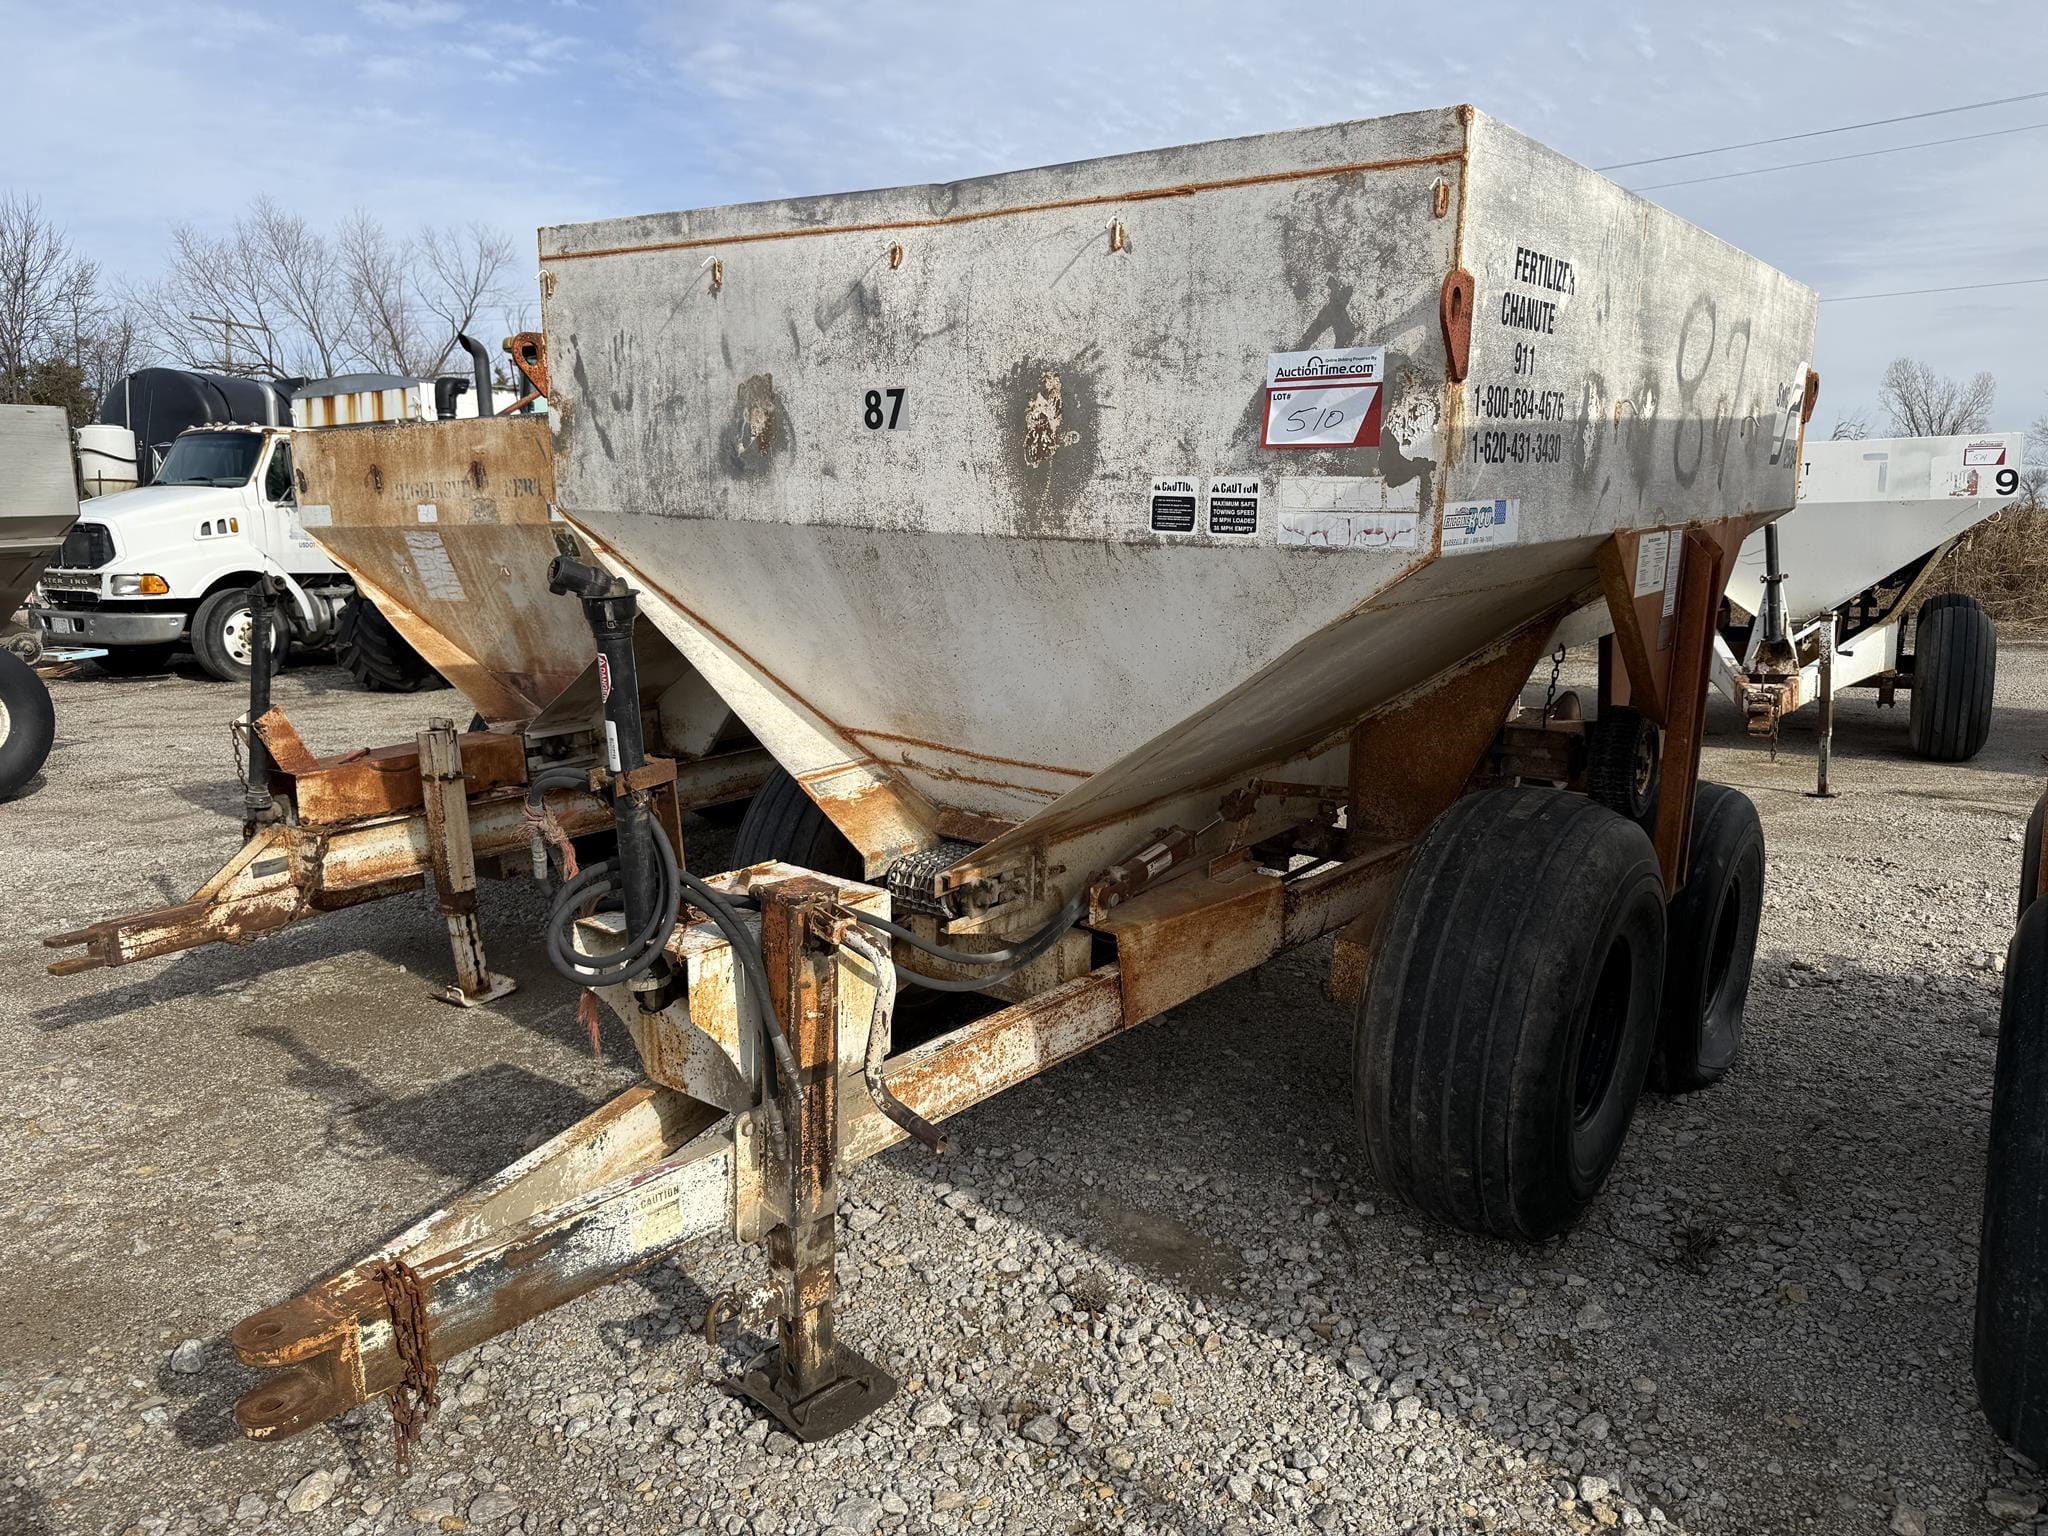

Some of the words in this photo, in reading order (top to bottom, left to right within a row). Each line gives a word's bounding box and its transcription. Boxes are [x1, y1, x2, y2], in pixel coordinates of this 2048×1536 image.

[1515, 246, 1575, 296] FERTILIZER
[1501, 291, 1556, 335] CHANUTE
[1275, 364, 1374, 378] AuctionTime.com
[1514, 341, 1535, 376] 911
[864, 388, 905, 430] 87
[1273, 393, 1292, 401] LOT#
[1474, 384, 1565, 423] 1-800-684-4676
[1286, 406, 1345, 432] 510
[1472, 431, 1562, 464] 1-620-431-3430
[1162, 481, 1194, 492] CAUTIO
[1995, 468, 2020, 496] 9
[1213, 508, 1235, 516] TOWING
[640, 1185, 679, 1209] CAUTION
